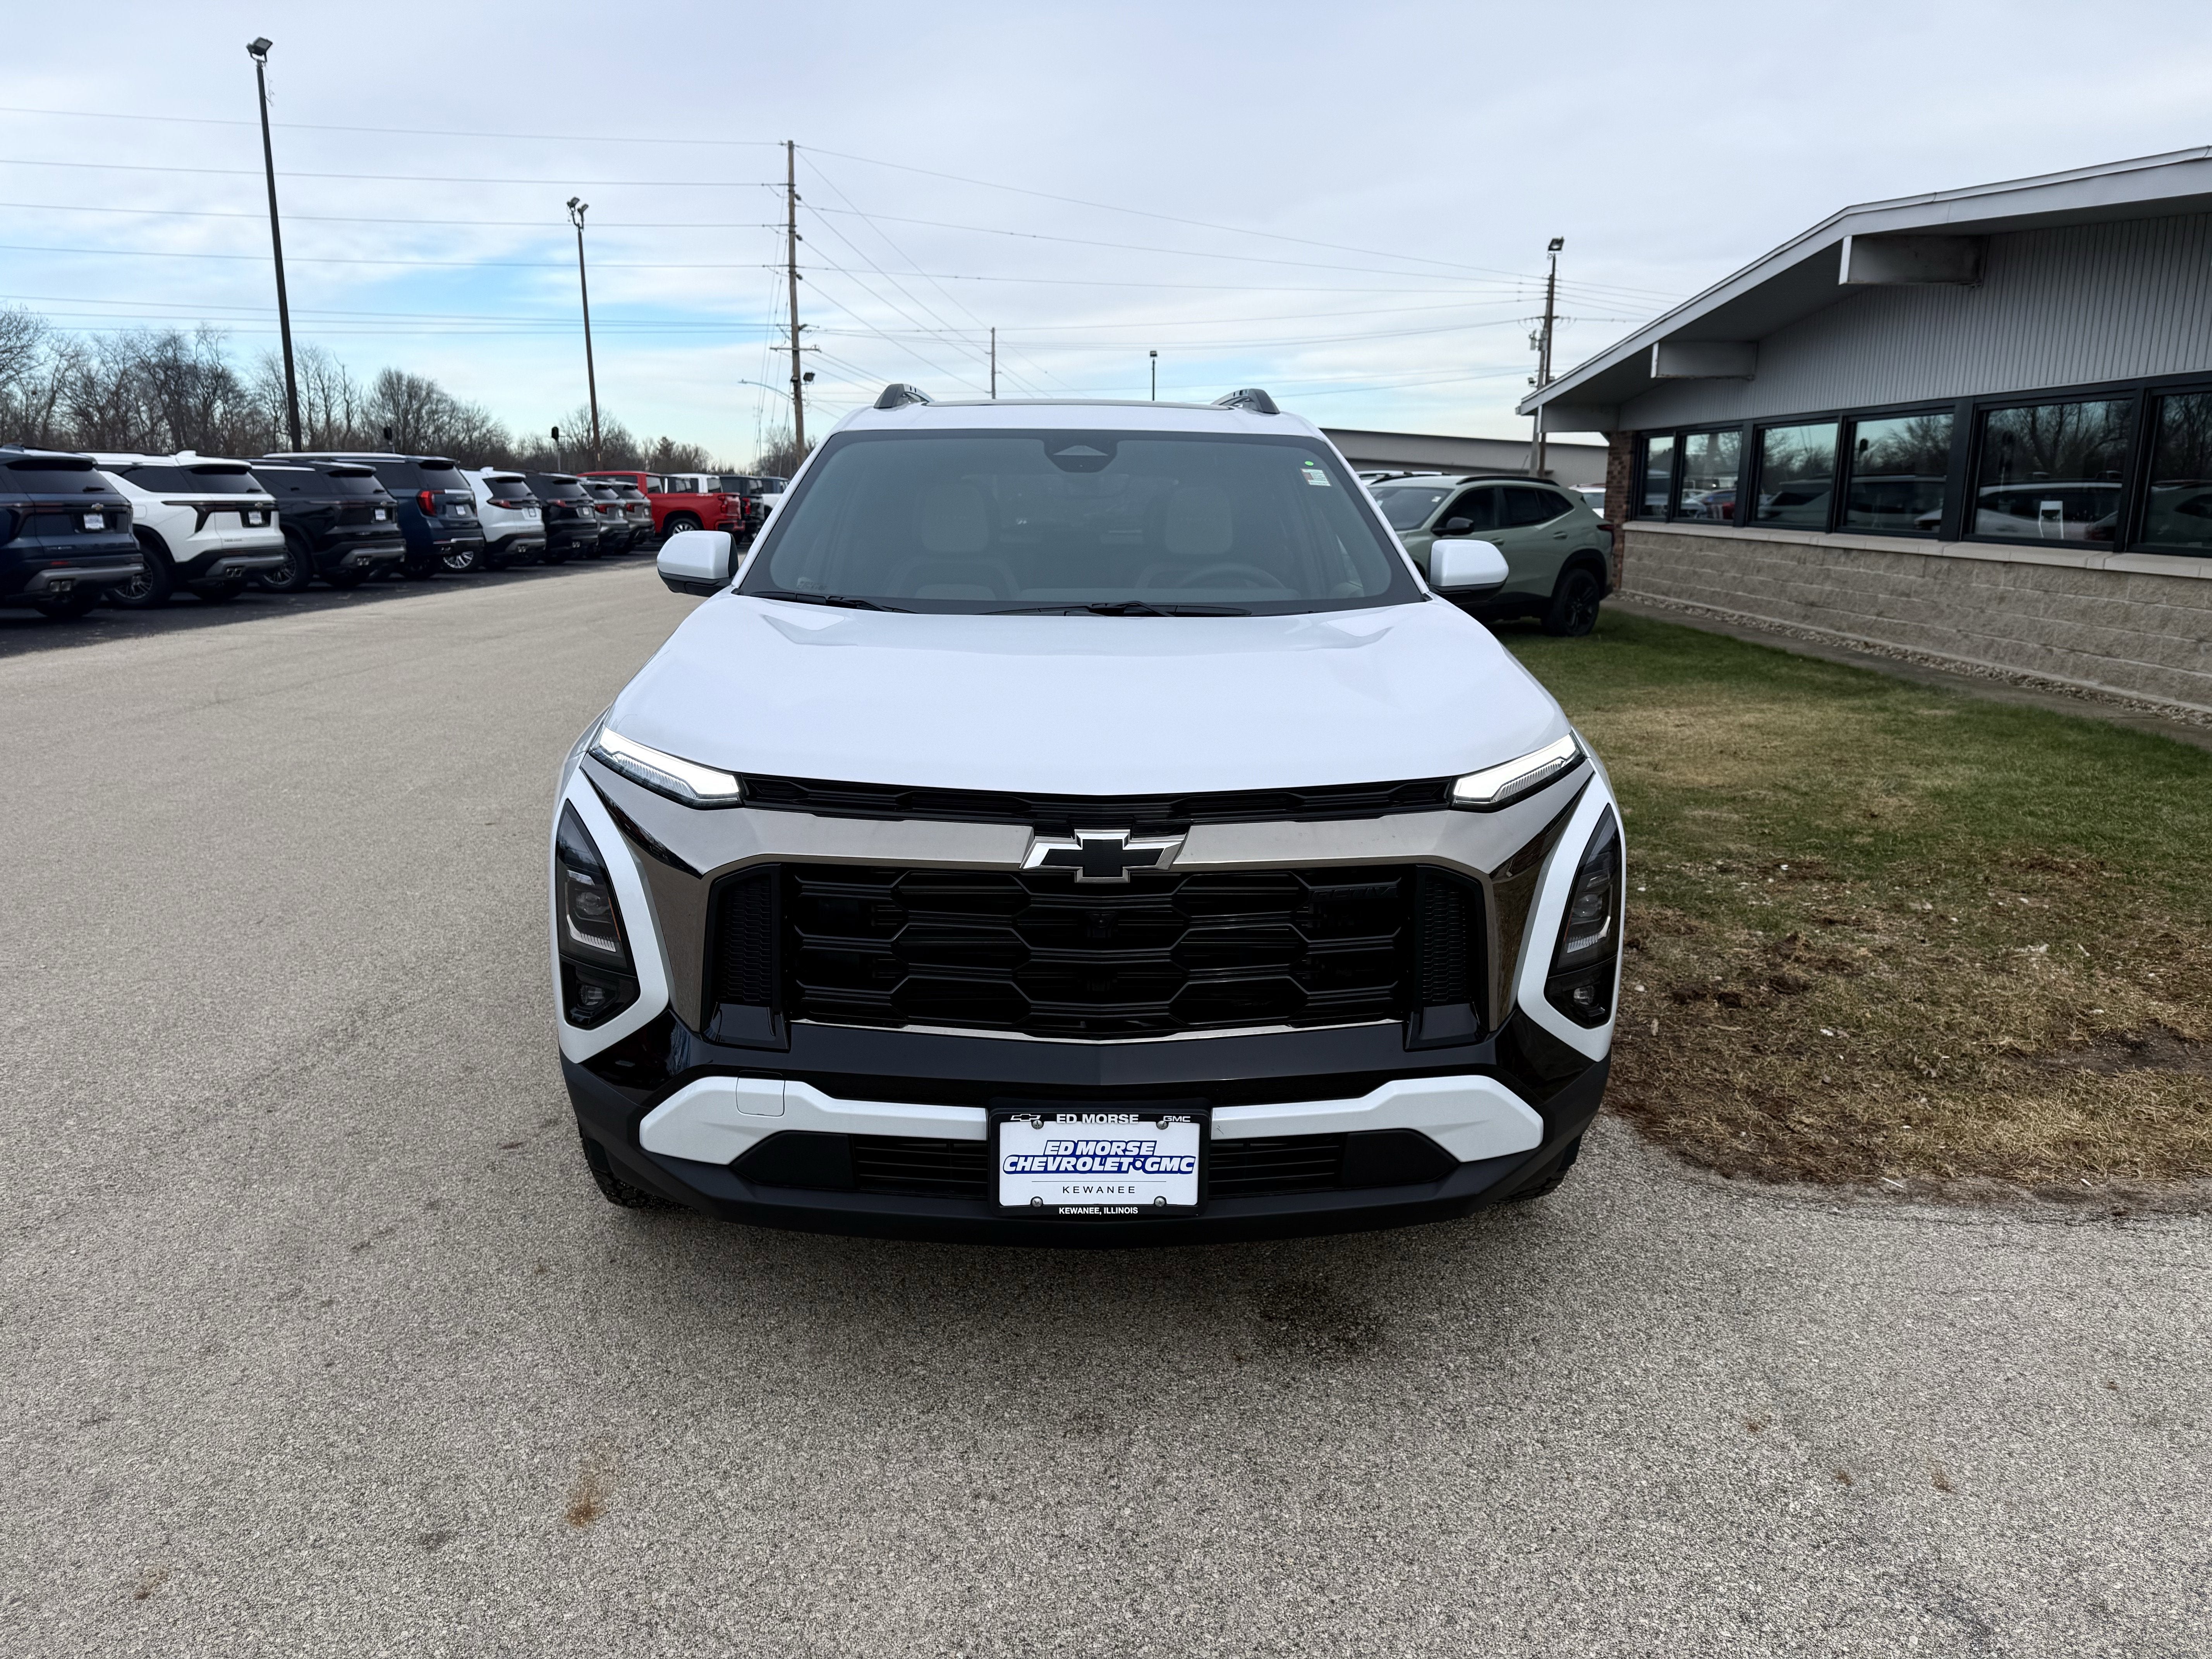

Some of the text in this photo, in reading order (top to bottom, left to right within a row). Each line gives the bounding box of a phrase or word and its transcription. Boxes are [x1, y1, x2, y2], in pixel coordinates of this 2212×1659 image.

[1056, 1114, 1139, 1124] ED MORSE
[1044, 1141, 1156, 1156] ED MORSE
[1059, 1207, 1102, 1215] KEWANEE,
